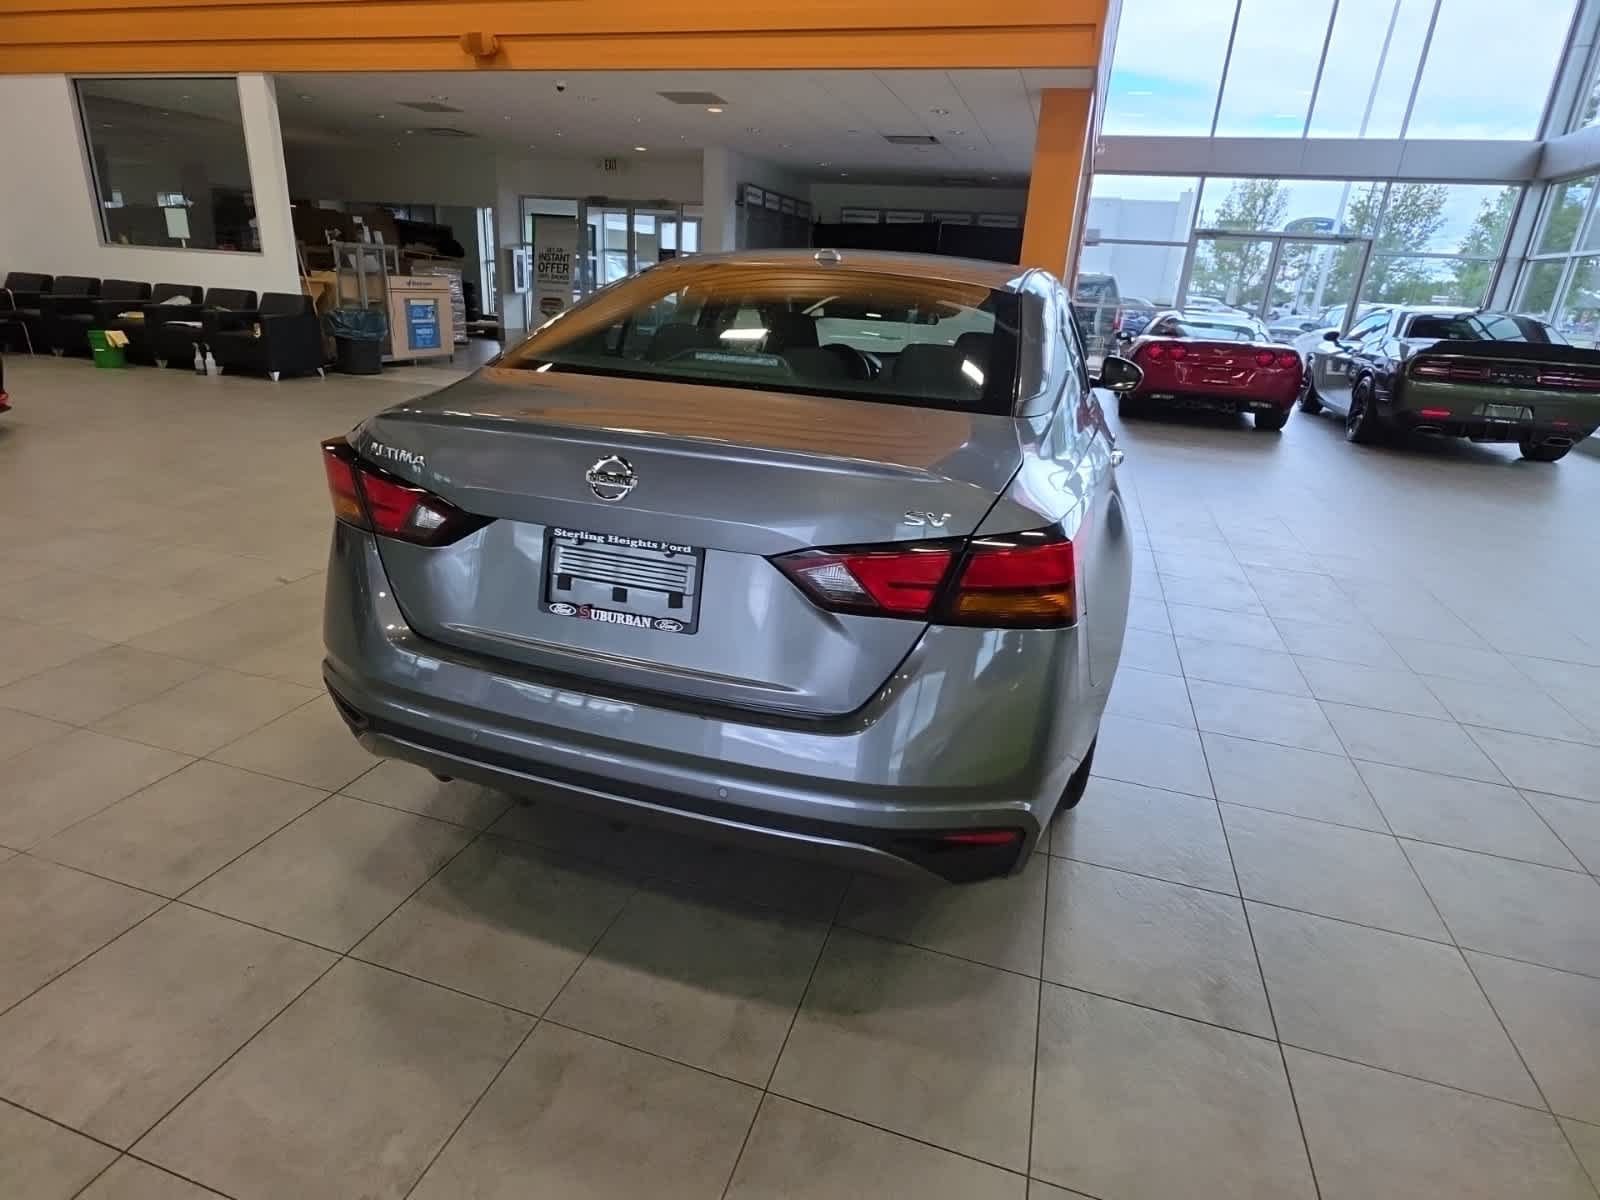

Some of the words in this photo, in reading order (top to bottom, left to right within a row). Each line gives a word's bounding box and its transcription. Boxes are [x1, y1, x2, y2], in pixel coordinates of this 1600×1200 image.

[538, 253, 571, 262] INSTANT
[538, 262, 570, 273] OFFER
[903, 512, 952, 527] SV
[553, 528, 605, 543] Sterling
[608, 535, 658, 549] Heights
[662, 541, 692, 553] Ford
[554, 603, 573, 615] Ford
[580, 607, 651, 627] SUBURBAN
[658, 620, 679, 631] Ford
